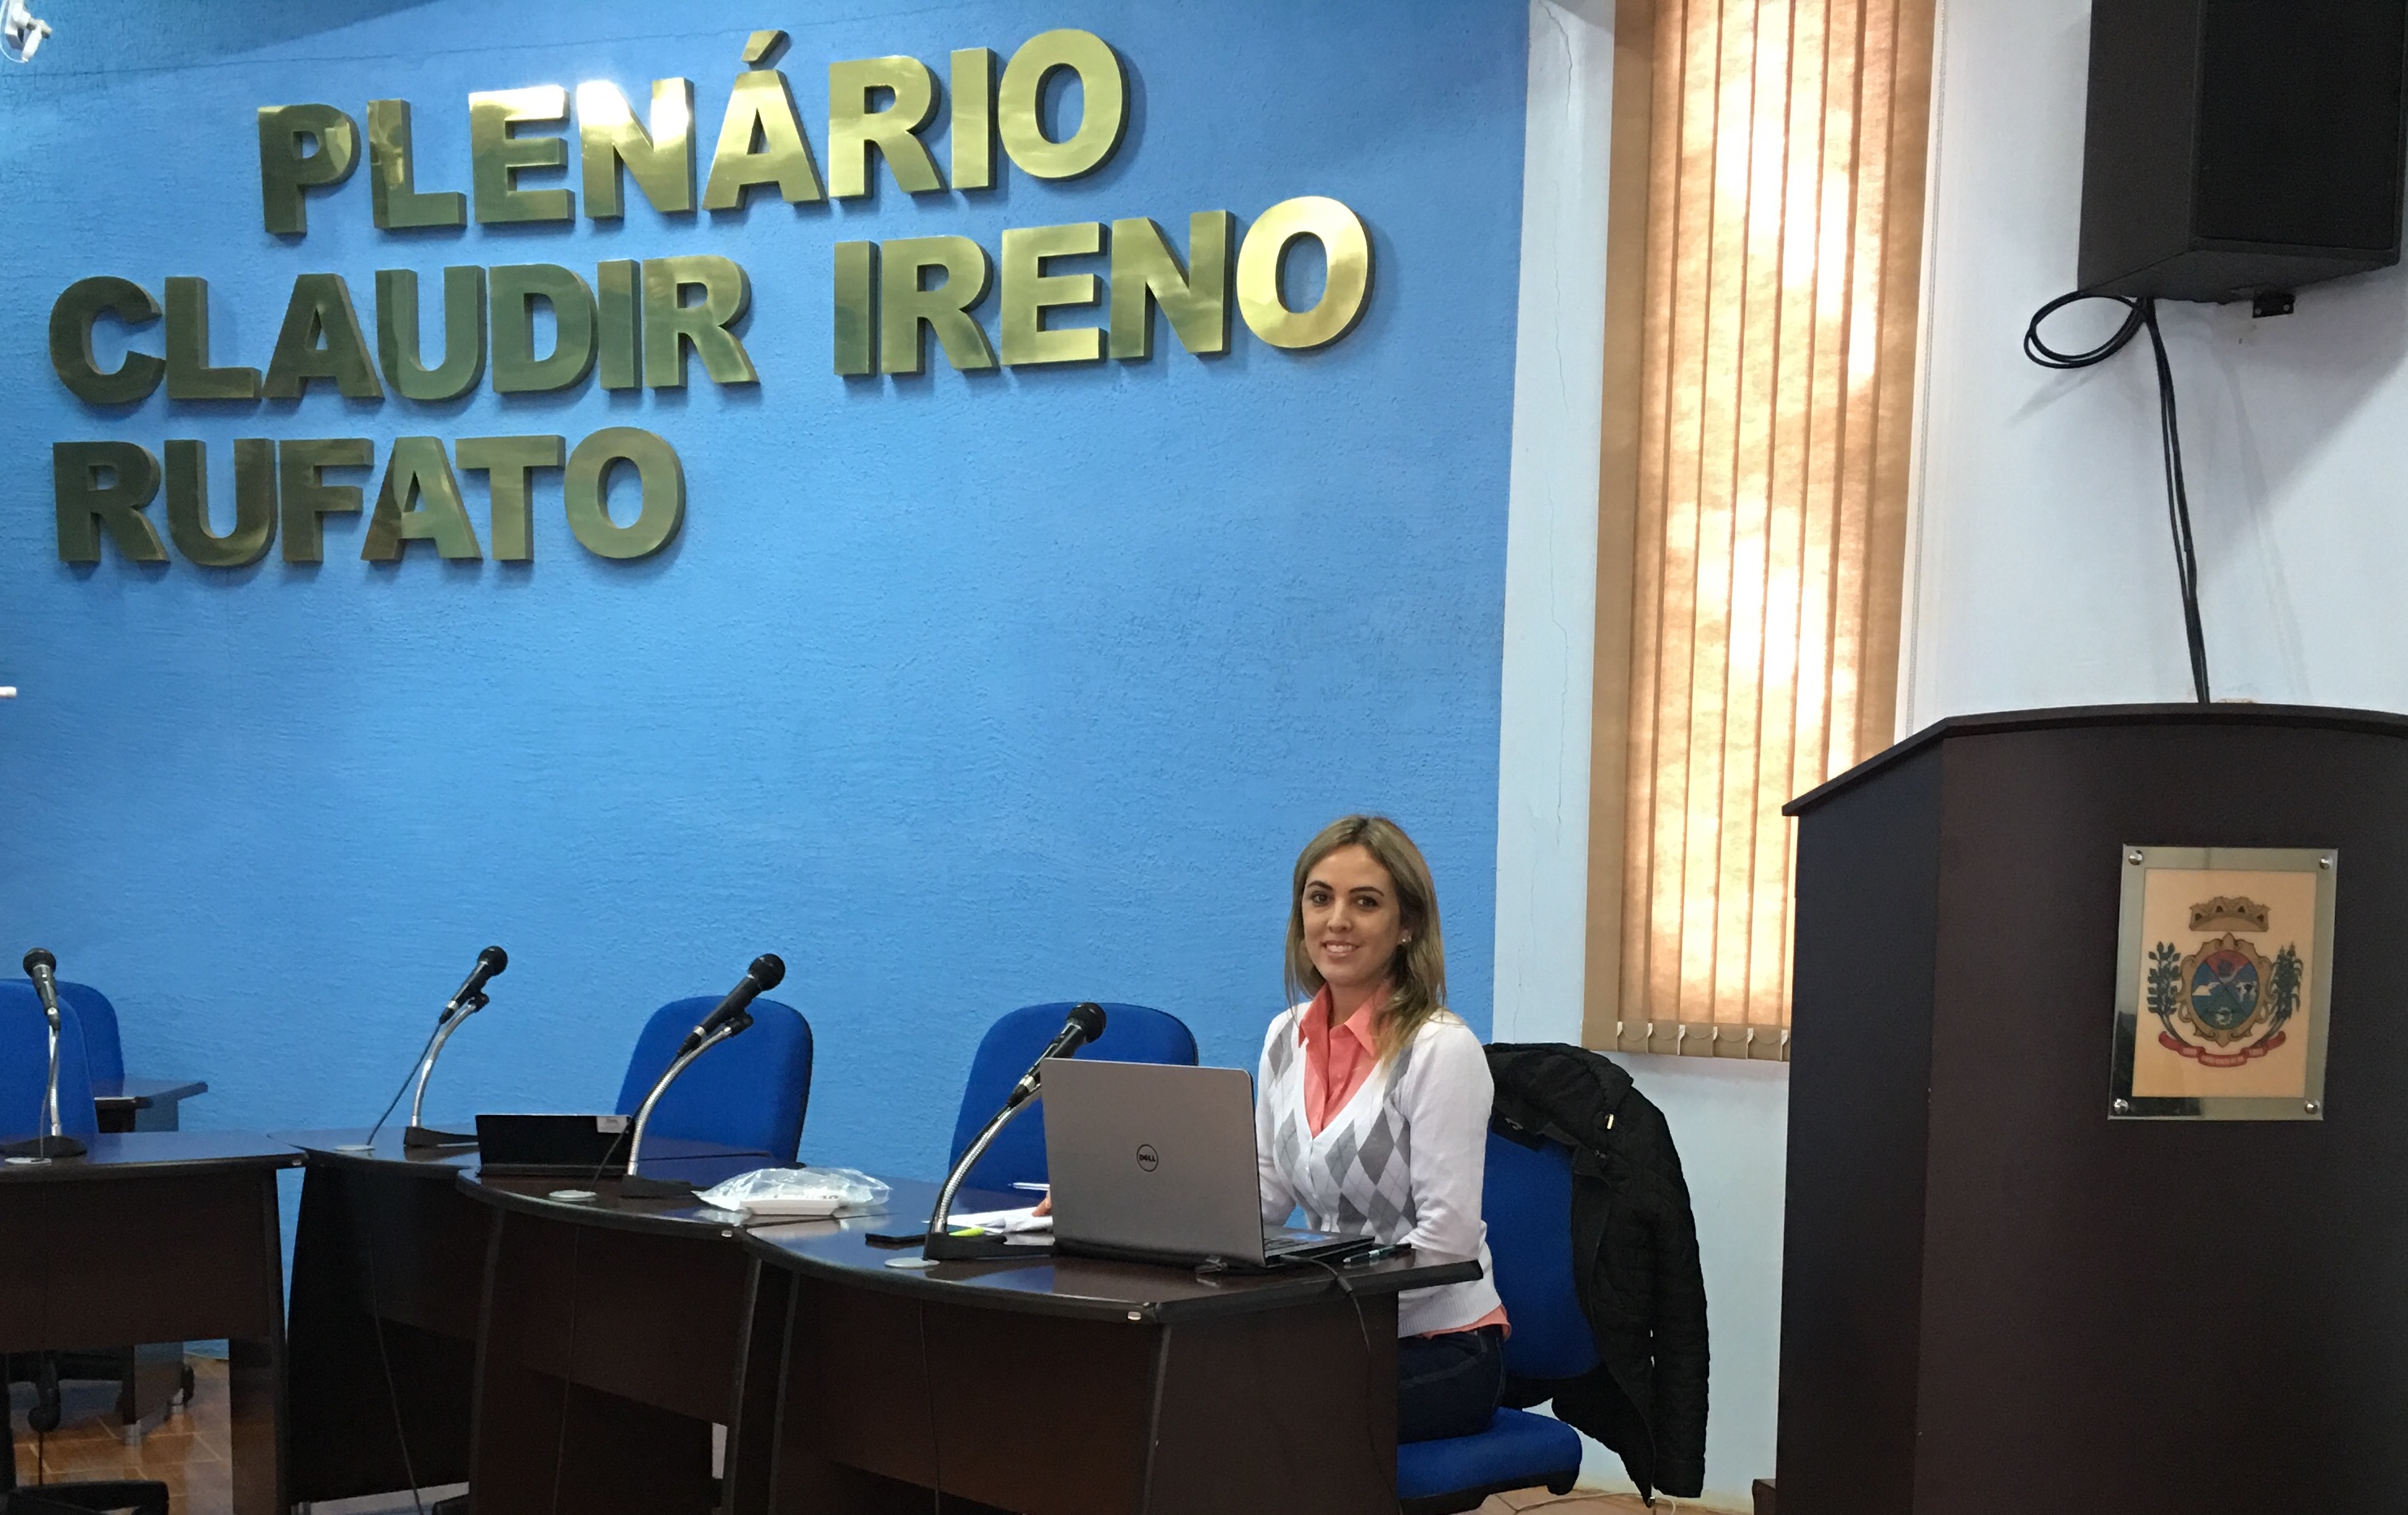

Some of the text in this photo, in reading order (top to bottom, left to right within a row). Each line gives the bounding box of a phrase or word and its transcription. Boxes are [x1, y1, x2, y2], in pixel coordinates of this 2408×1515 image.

[257, 28, 1130, 235] PLENÁRIO
[49, 195, 1375, 405] CLAUDIR IRENO
[53, 426, 687, 566] RUFATO
[1139, 1154, 1156, 1162] DELL
